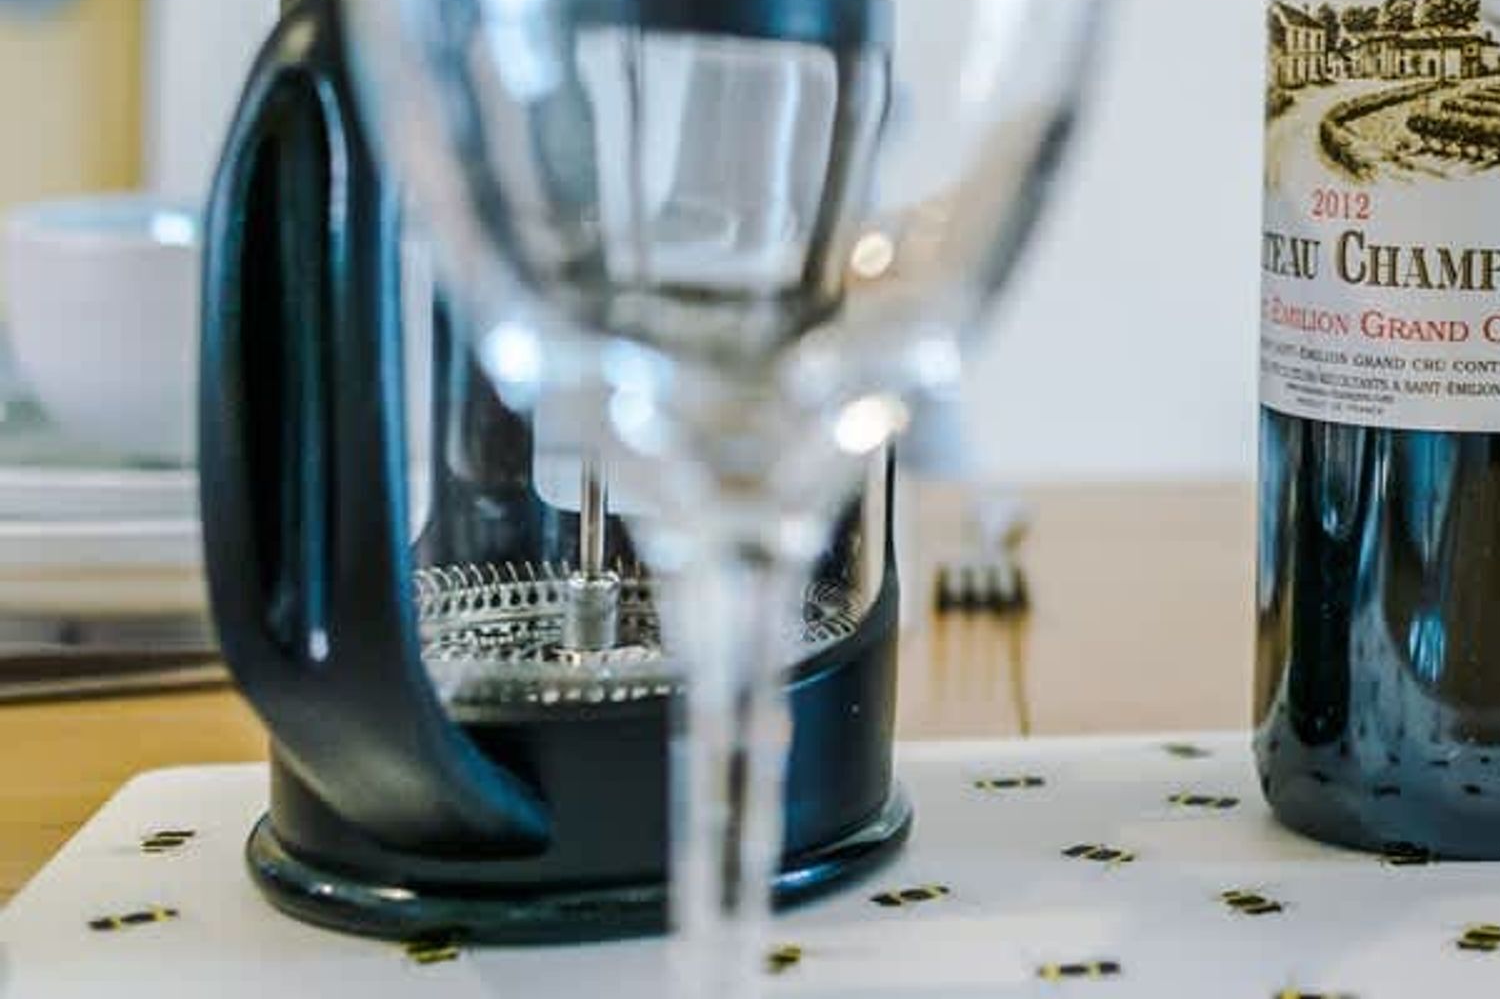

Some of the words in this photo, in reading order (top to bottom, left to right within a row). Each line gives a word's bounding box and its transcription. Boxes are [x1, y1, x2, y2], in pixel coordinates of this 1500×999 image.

[1311, 188, 1370, 220] 2012
[1360, 310, 1469, 343] GRAND
[1352, 352, 1406, 371] GRAND
[1412, 358, 1447, 372] CRU
